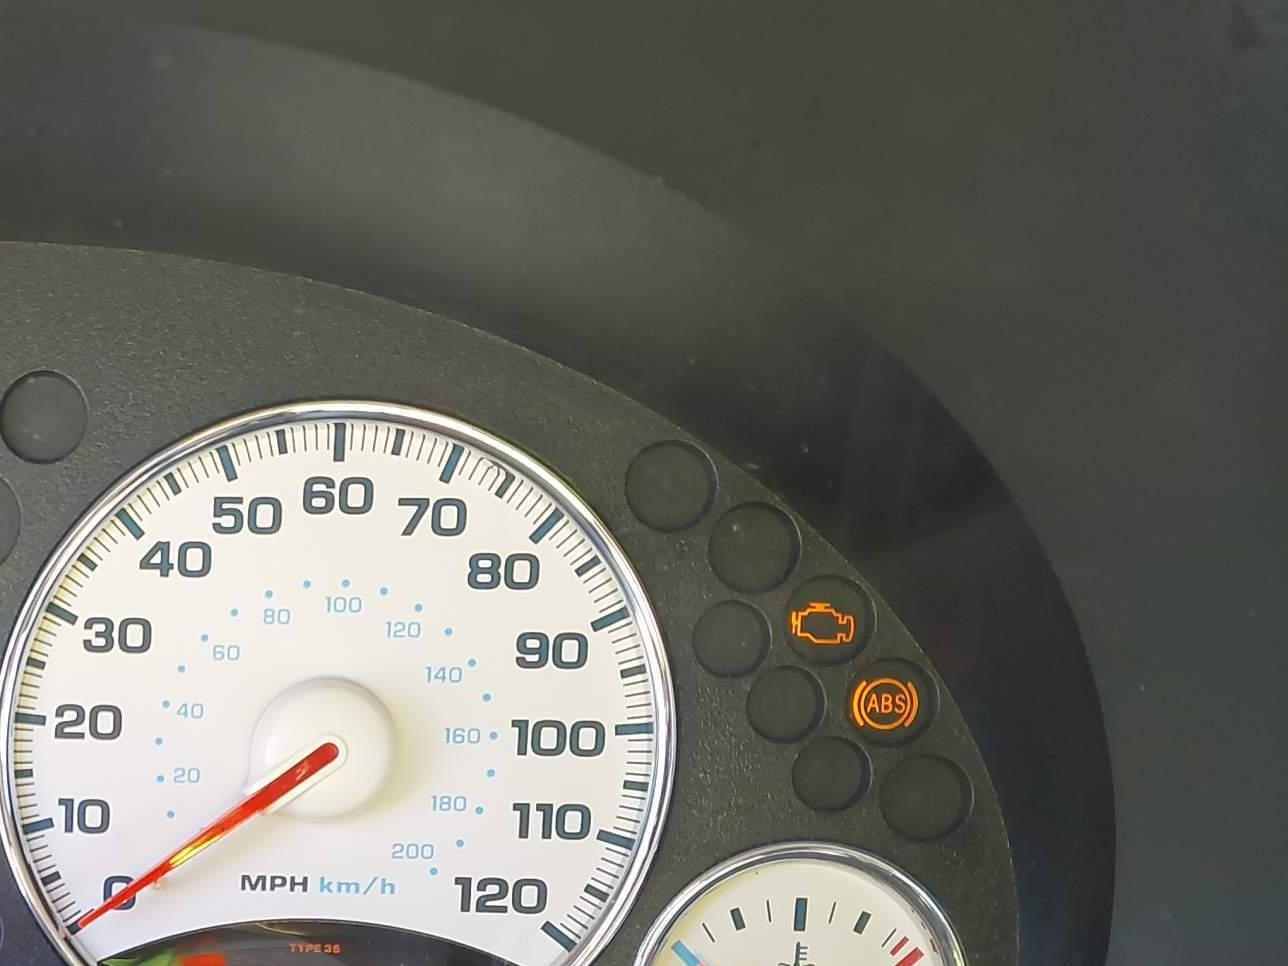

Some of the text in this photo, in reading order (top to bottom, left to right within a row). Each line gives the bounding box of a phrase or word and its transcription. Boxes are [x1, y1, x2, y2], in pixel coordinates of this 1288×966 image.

[303, 476, 373, 514] 60
[212, 497, 282, 534] 50
[398, 498, 467, 536] 70
[138, 538, 211, 577] 40
[468, 553, 540, 590] 80
[264, 609, 290, 624] 80
[326, 597, 361, 613] 100
[83, 617, 151, 653] 30
[386, 622, 420, 638] 120
[213, 645, 240, 660] 60
[516, 632, 588, 669] 90
[426, 667, 462, 683] 140
[177, 703, 203, 718] 40
[867, 693, 905, 714] ABS
[55, 704, 122, 740] 20
[445, 728, 480, 743] 160
[512, 720, 605, 757] 100
[174, 768, 200, 783] 20
[58, 798, 110, 834] 10
[432, 796, 466, 811] 180
[513, 803, 591, 840] 110
[392, 844, 433, 859] 200
[103, 875, 136, 910] 0
[241, 875, 395, 895] MPH km/h
[455, 877, 547, 914] 120
[289, 944, 321, 952] TYPE
